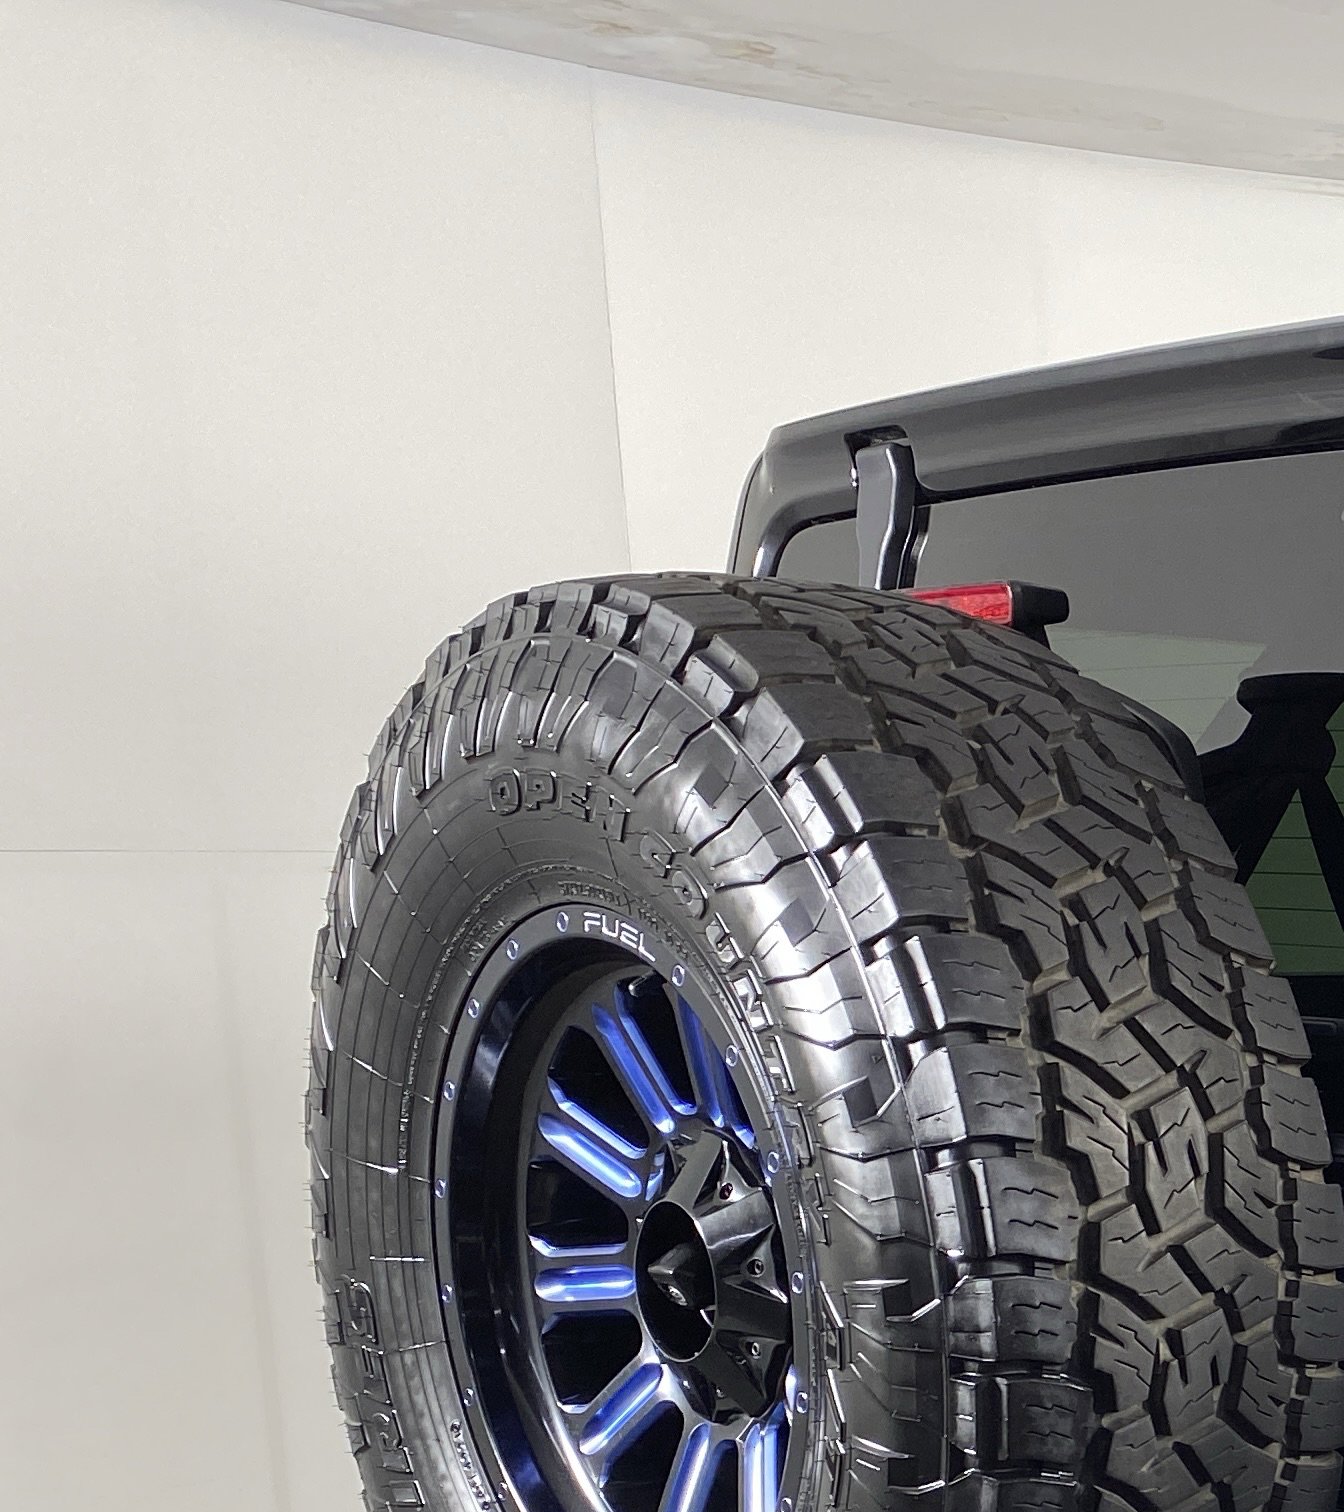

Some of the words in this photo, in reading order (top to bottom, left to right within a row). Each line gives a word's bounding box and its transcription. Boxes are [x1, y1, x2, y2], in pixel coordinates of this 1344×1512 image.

[487, 766, 632, 842] OPEN
[637, 828, 833, 1248] COUNTRY
[582, 910, 657, 963] FUEL
